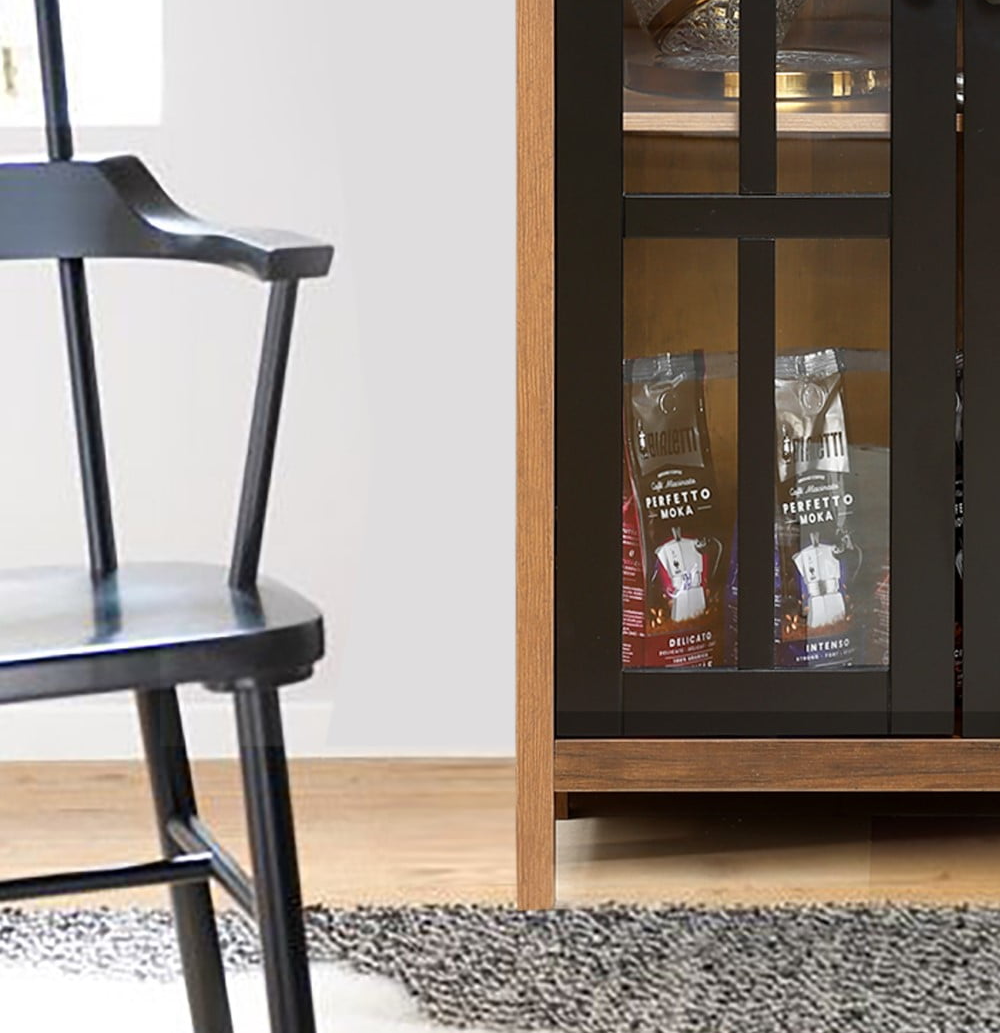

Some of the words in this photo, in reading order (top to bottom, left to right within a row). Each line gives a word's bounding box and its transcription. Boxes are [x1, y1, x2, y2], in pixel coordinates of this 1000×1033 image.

[645, 487, 711, 509] PERFETTO
[782, 493, 853, 514] PERFETTO
[660, 505, 694, 519] MOKA
[799, 510, 833, 525] MOKA
[669, 631, 712, 647] DELICATO
[806, 638, 850, 653] INTENSO
